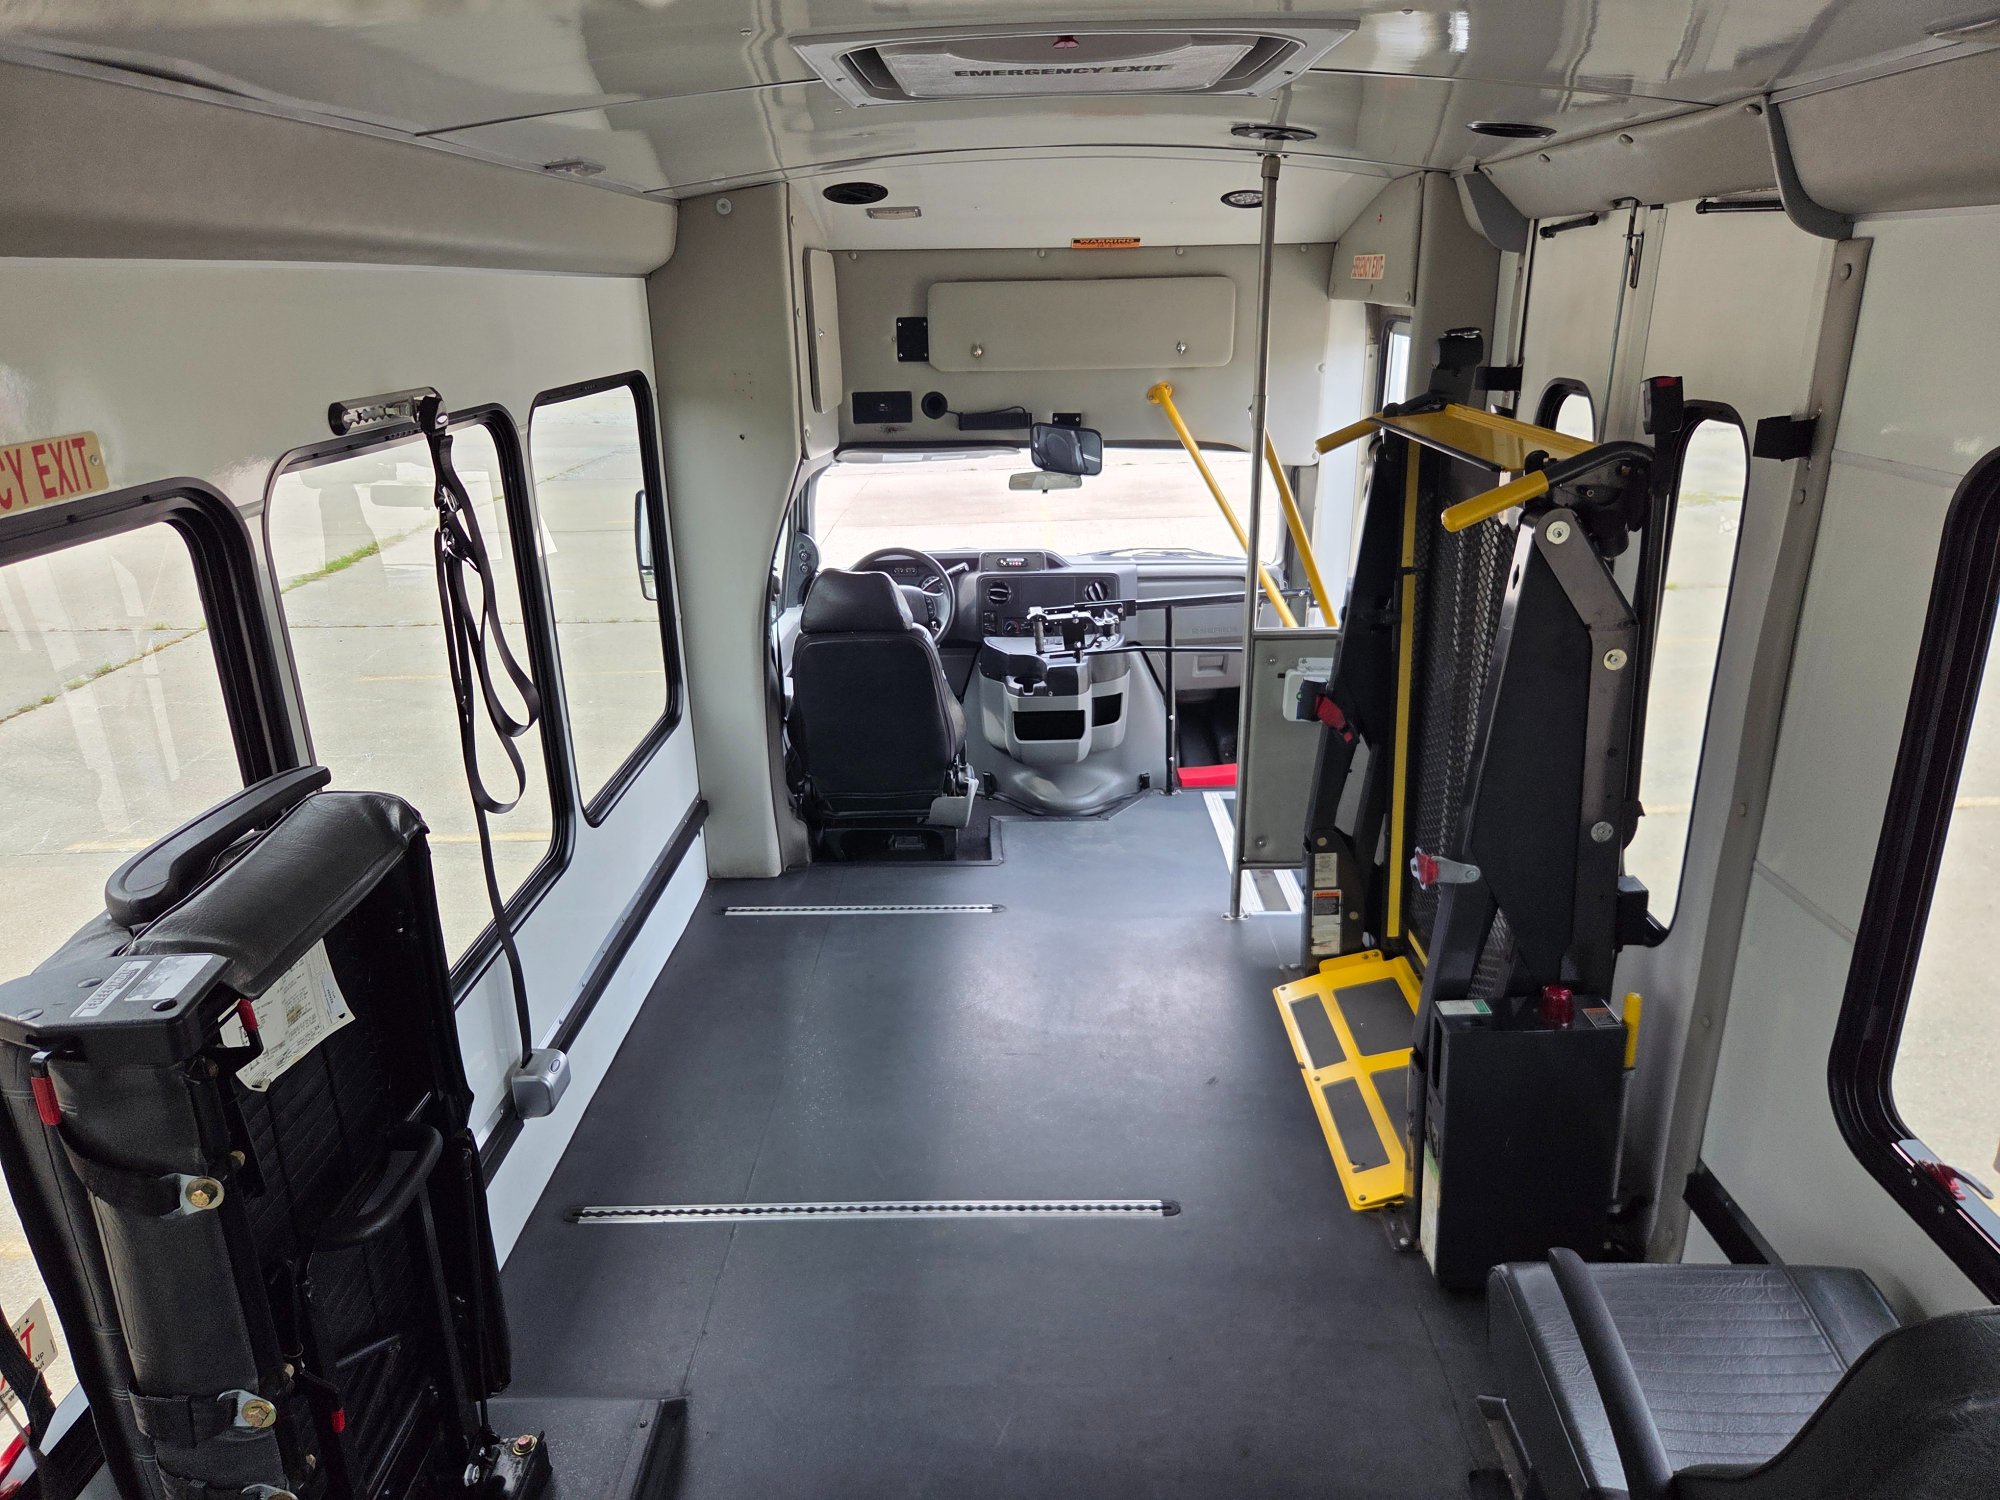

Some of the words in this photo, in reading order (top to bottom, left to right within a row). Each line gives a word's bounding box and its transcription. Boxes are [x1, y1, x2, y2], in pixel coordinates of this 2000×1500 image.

[954, 66, 1105, 77] EMERGENCY
[1112, 64, 1169, 73] EXIT
[31, 437, 92, 499] EXIT
